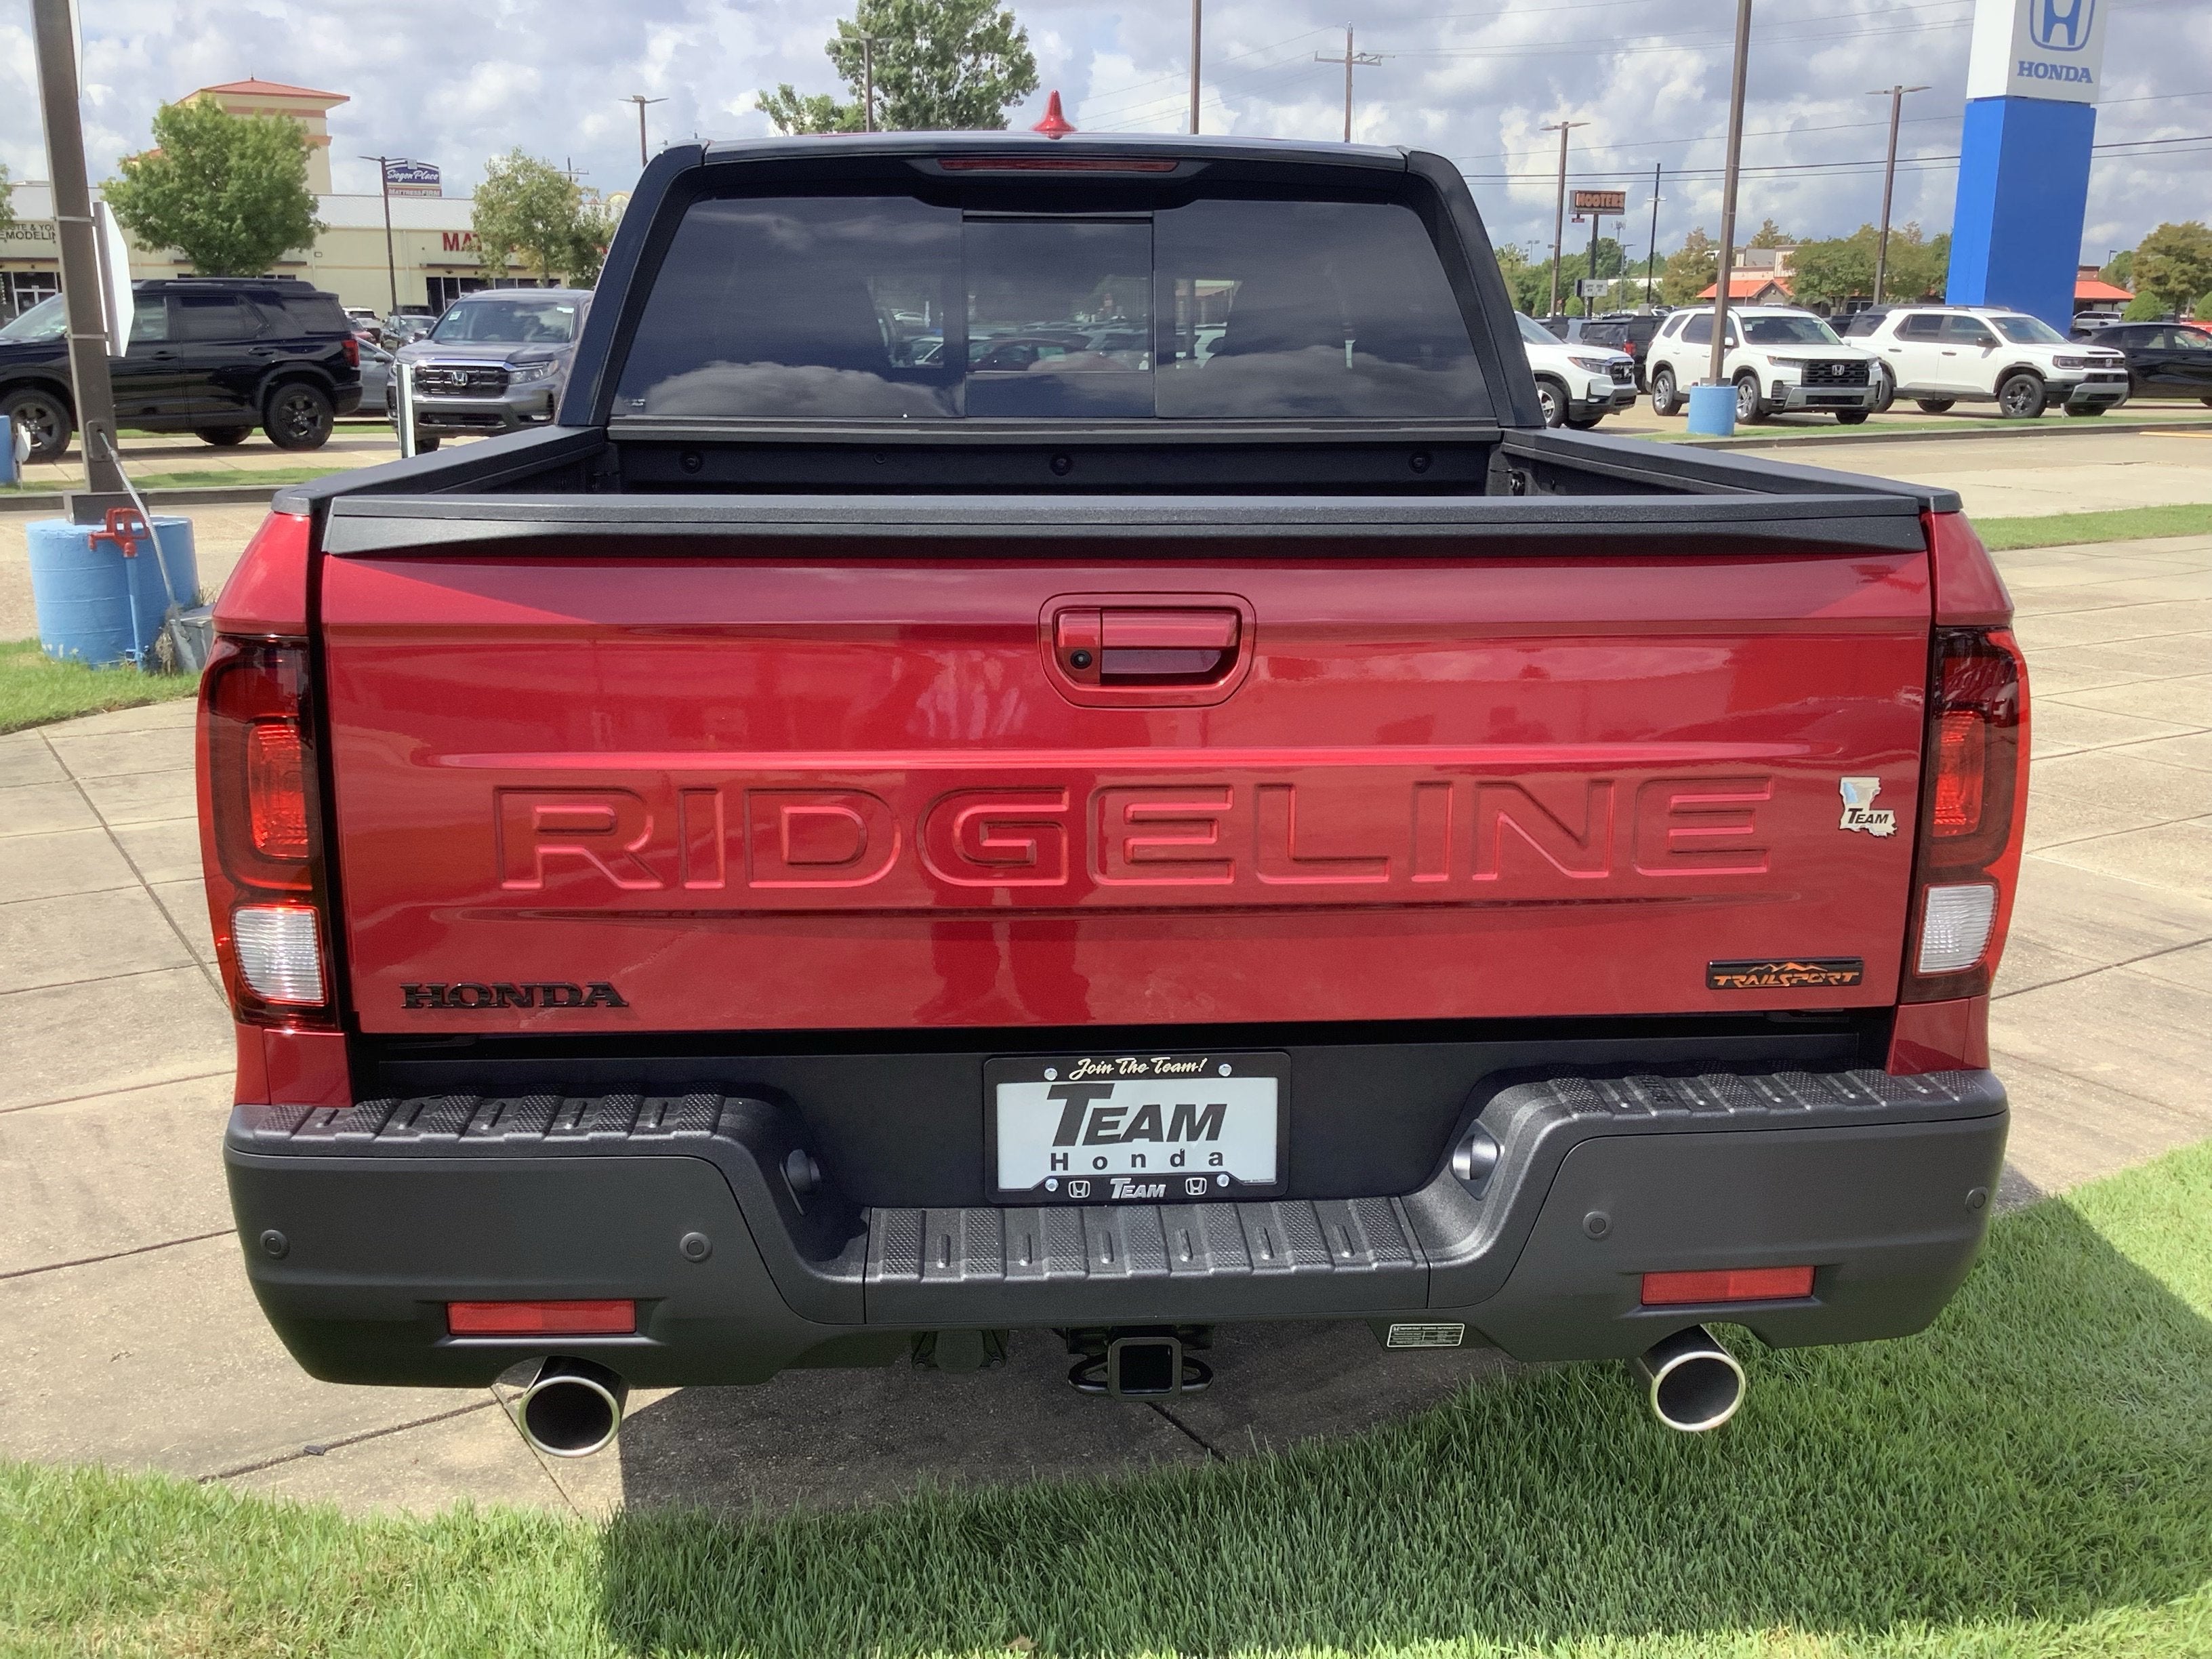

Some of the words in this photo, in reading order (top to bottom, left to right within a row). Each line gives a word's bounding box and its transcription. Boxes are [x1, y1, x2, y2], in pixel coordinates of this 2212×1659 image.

[2017, 60, 2093, 83] HONDA
[413, 170, 438, 180] Place
[1576, 193, 1624, 207] HOOTERS
[1848, 808, 1889, 823] TEAM
[493, 775, 1773, 890] RIDGELINE
[1713, 972, 1860, 988] TRAILSPORT
[401, 982, 630, 1008] HONDA
[1069, 1058, 1115, 1080] Join
[1115, 1057, 1149, 1075] The
[1150, 1057, 1208, 1074] Team!
[1046, 1083, 1227, 1147] TEAM
[1050, 1148, 1224, 1172] Honda
[1109, 1177, 1166, 1199] TEAM
